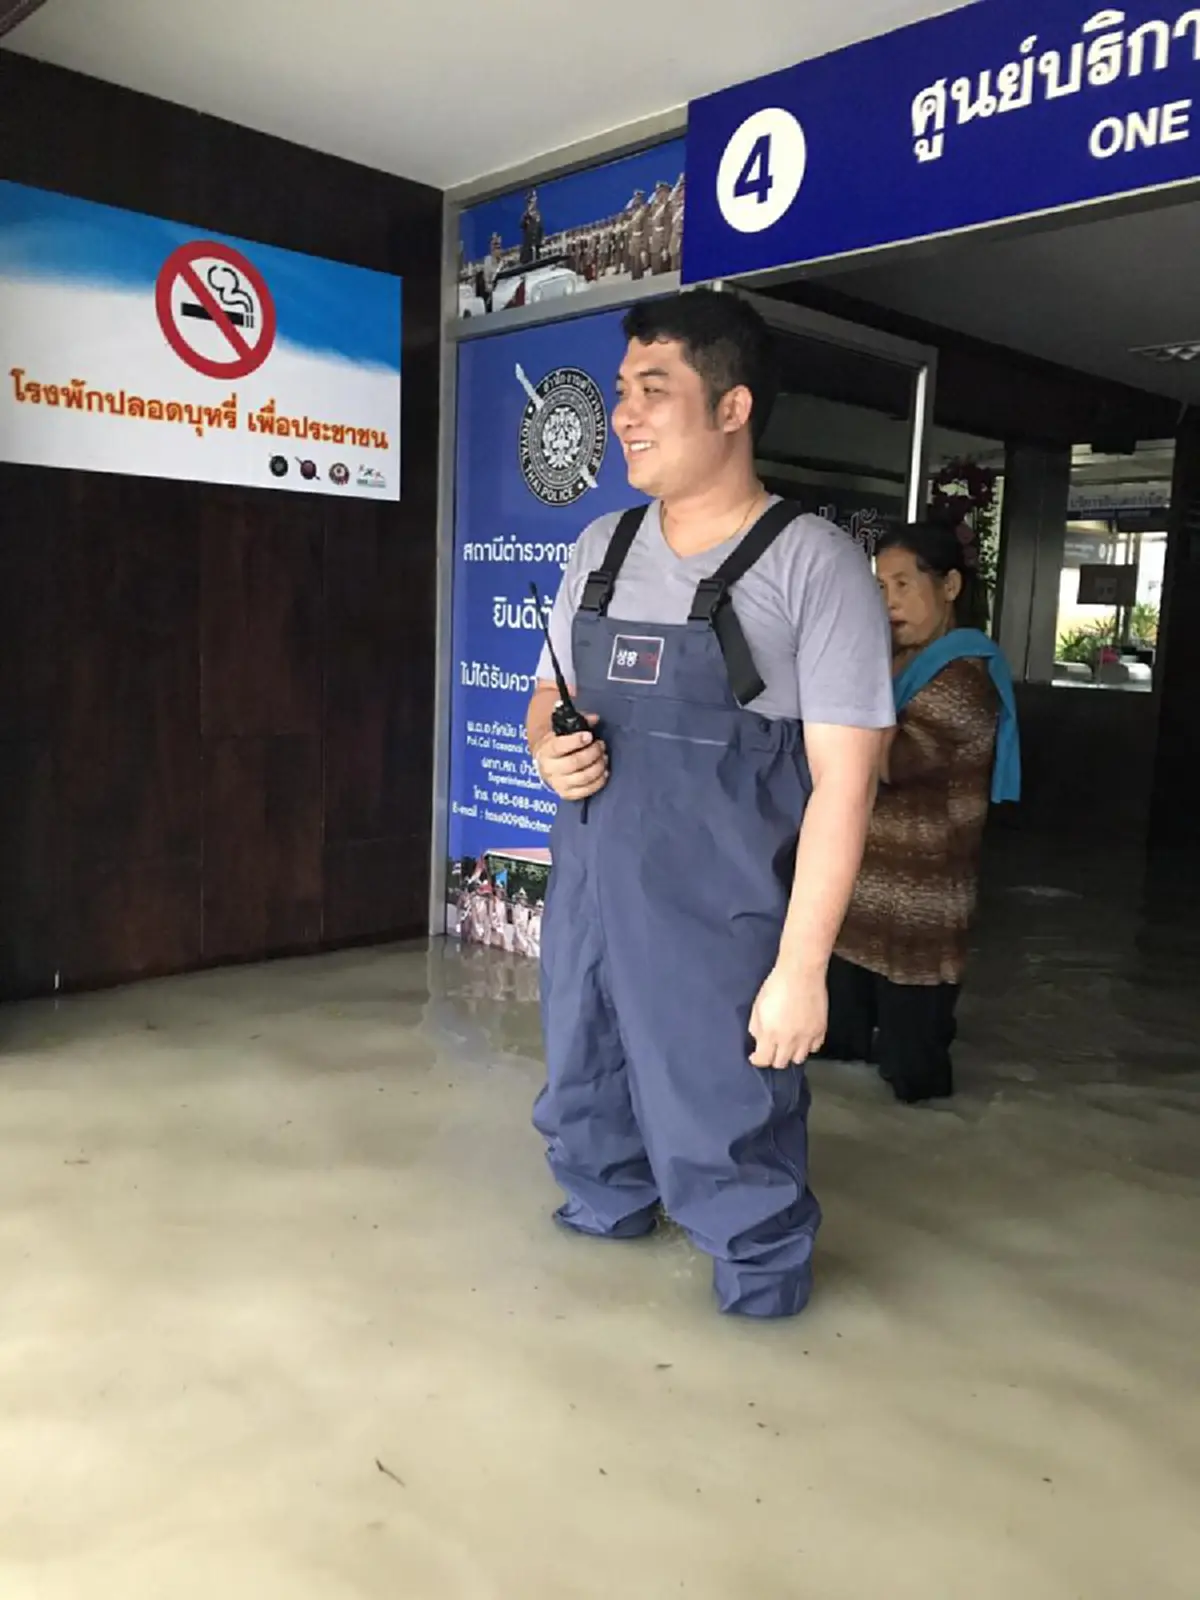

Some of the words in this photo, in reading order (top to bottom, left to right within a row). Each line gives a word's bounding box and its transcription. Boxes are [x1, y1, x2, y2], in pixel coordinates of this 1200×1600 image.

[911, 9, 1200, 162] ศูนย์บริกา
[1088, 98, 1193, 160] ONE
[733, 132, 774, 204] 4
[9, 367, 238, 437] โรงพักปลอดบุหรี่
[248, 399, 389, 450] เพื่อประชาชน
[541, 487, 574, 502] POLICE
